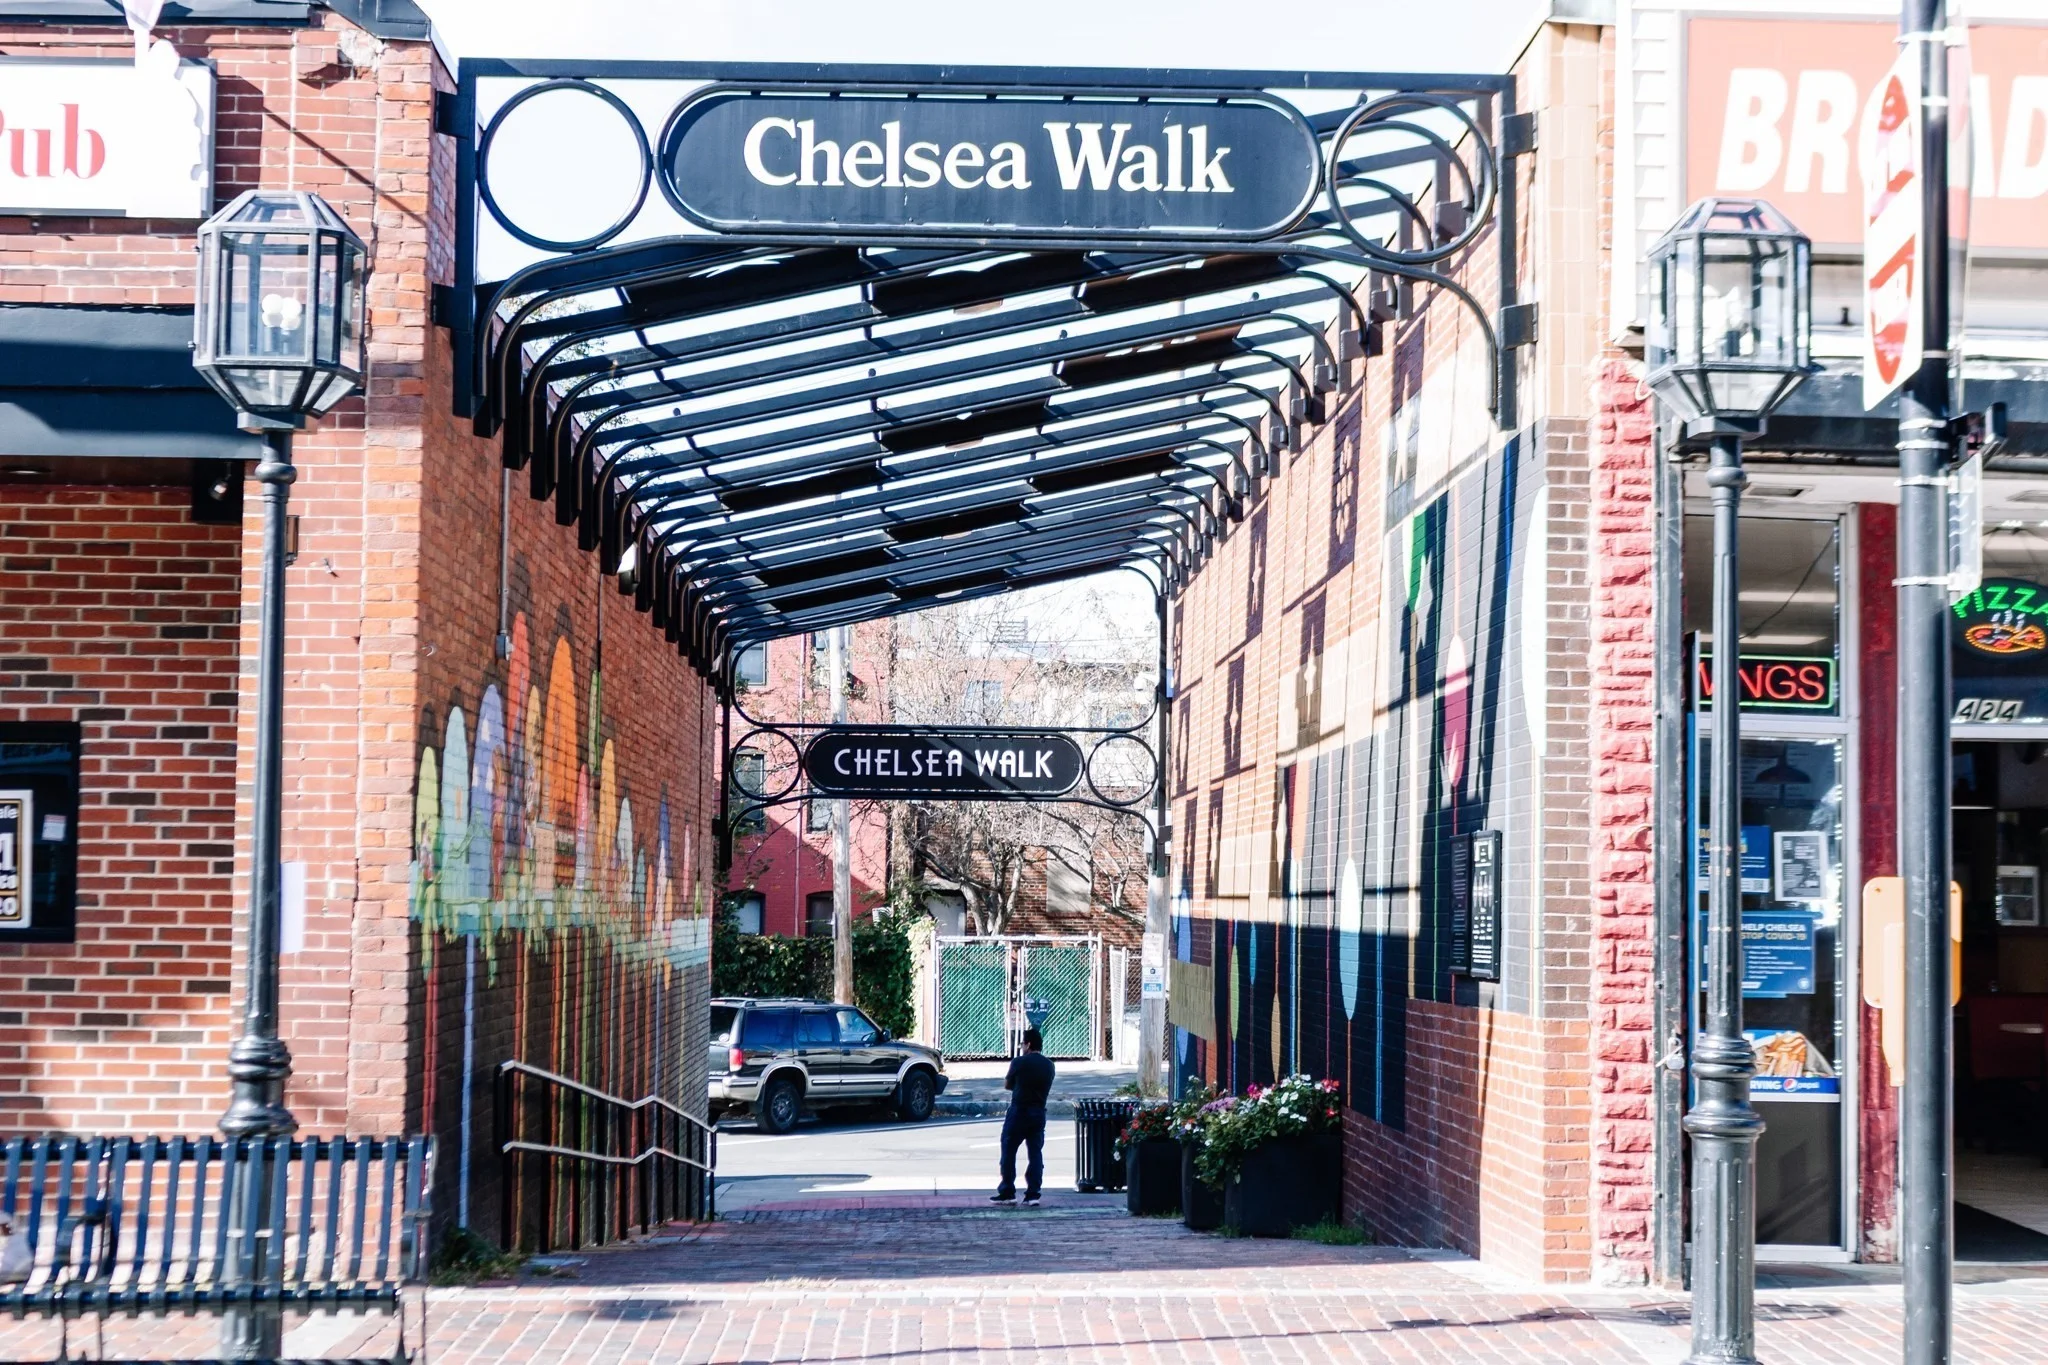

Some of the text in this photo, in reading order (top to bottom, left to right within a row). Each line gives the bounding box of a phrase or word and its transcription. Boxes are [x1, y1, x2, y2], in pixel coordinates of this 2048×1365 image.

[0, 103, 106, 179] ub
[743, 117, 1234, 194] Chelsea Walk
[1699, 662, 1825, 701] NGS
[1960, 701, 2018, 721] 424
[834, 748, 1053, 778] CHELSEA WALK
[1741, 923, 1806, 932] HELP CHELSEA
[1741, 932, 1807, 941] STOP COVID-19
